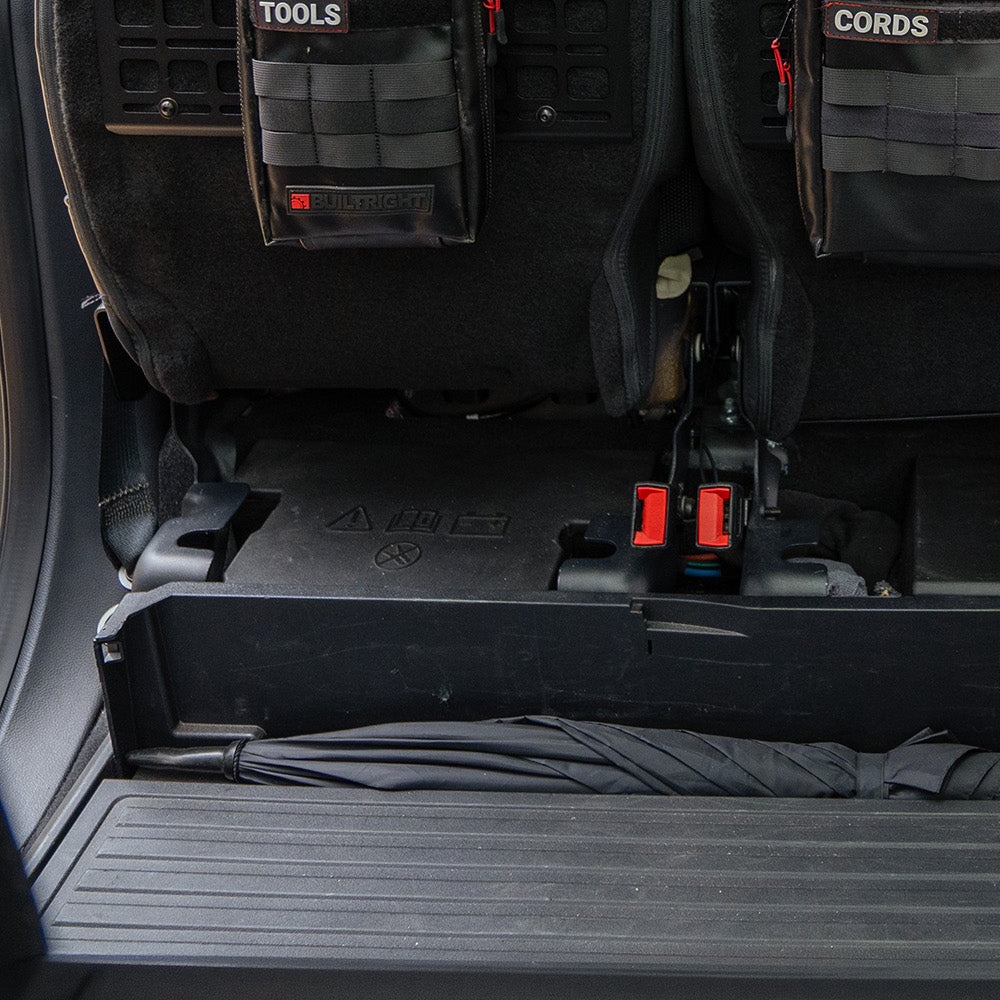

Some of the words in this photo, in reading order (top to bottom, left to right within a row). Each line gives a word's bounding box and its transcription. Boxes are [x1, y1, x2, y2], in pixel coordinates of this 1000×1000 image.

[259, 1, 341, 26] TOOLS
[834, 9, 930, 38] CORDS
[310, 193, 427, 209] BUILTRIGHT
